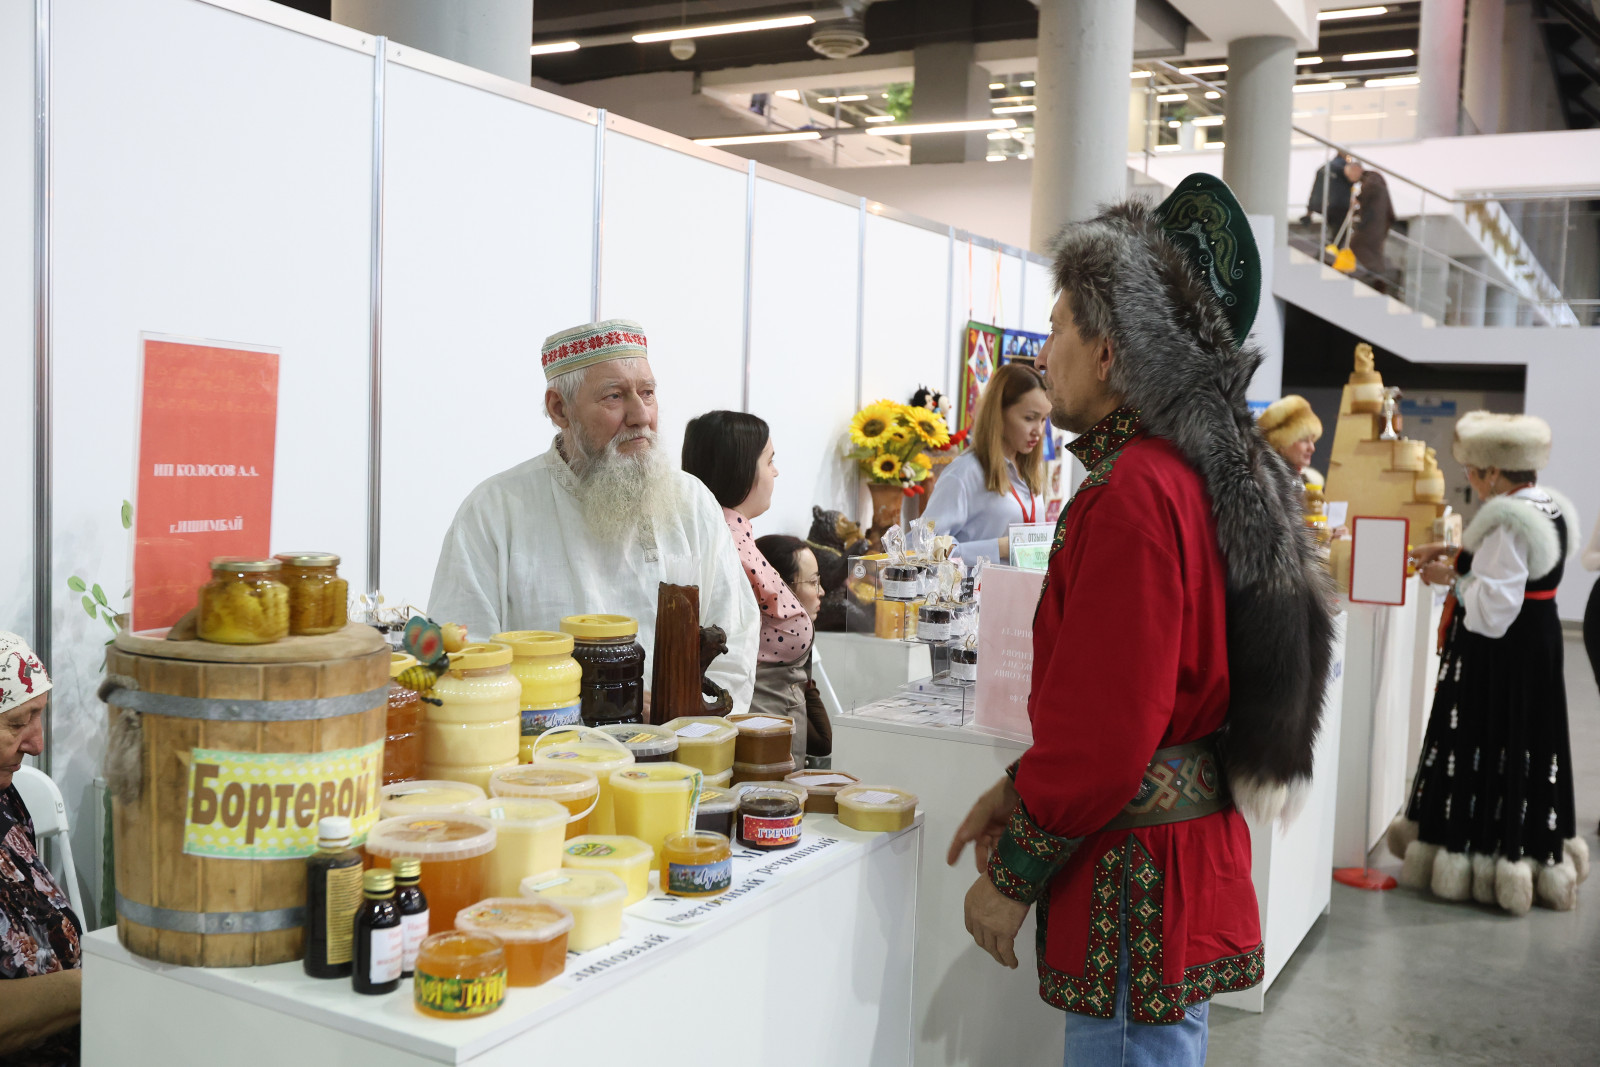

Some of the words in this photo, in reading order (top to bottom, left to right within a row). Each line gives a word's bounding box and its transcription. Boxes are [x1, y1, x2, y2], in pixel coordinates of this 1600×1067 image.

[153, 463, 174, 477] ИП
[176, 463, 236, 477] КОЛОСОВ
[191, 757, 370, 845] Бортевой
[570, 933, 671, 982] липовый
